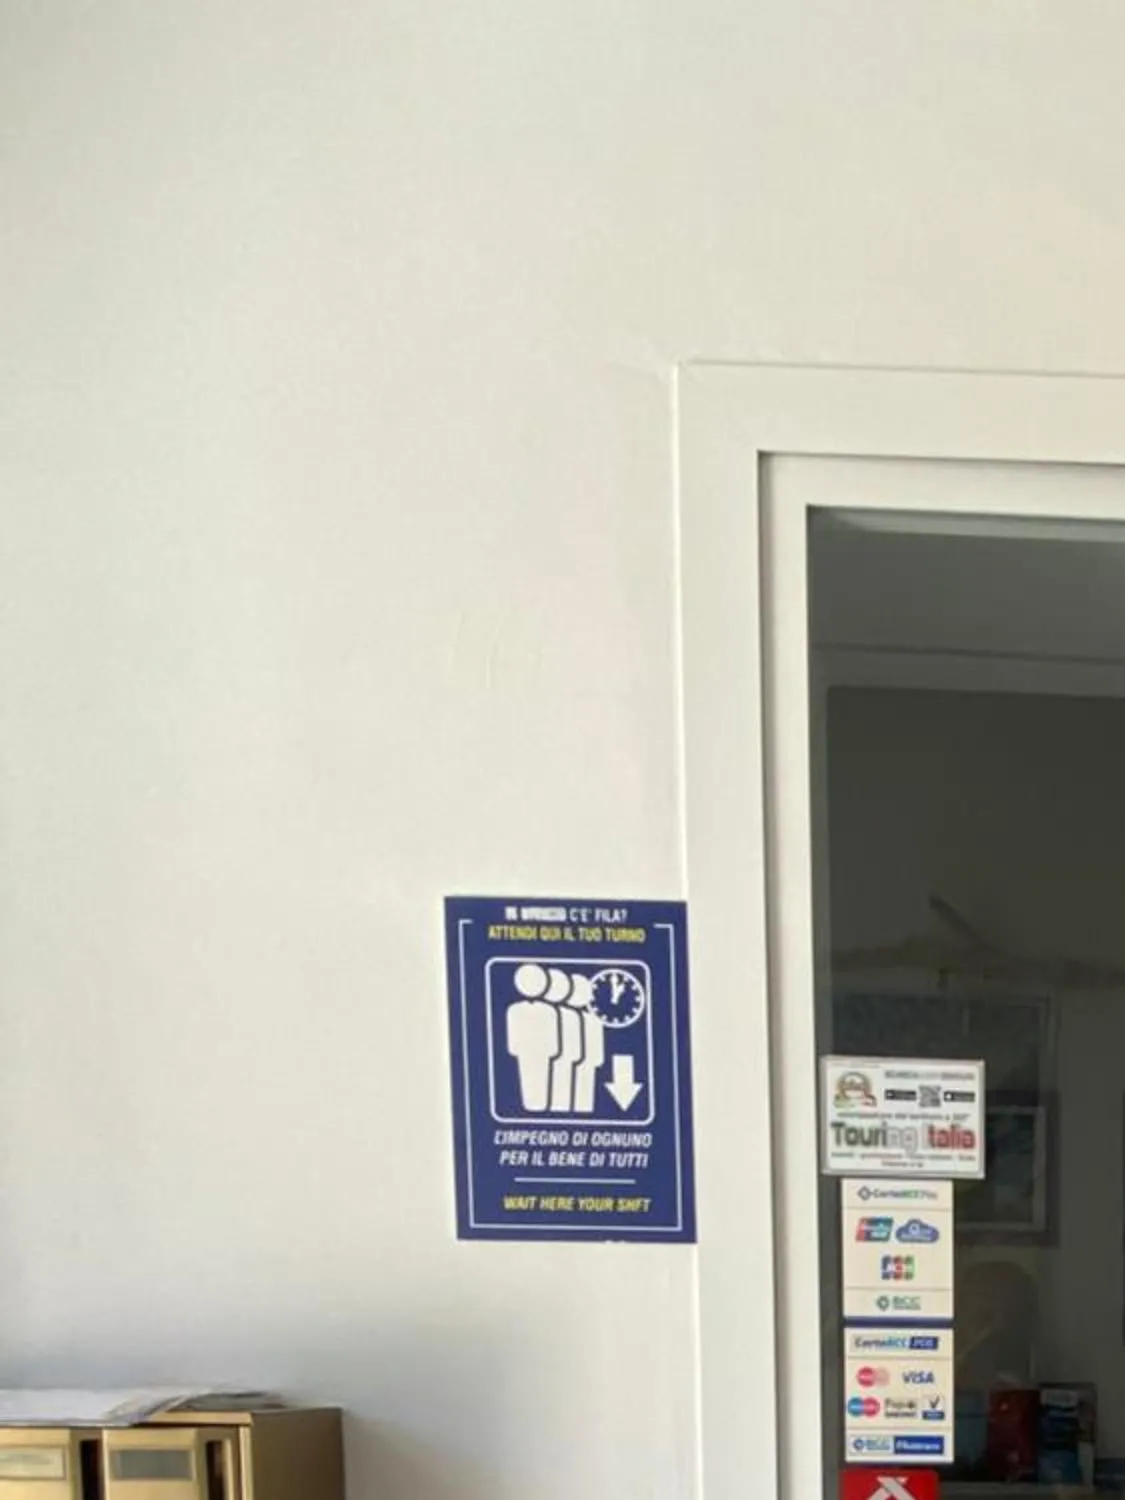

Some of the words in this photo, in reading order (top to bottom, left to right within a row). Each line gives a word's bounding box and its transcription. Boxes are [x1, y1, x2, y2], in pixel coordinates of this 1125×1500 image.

[488, 925, 538, 941] ATTENDI
[572, 1132, 588, 1147] DI
[591, 1132, 653, 1148] OGNUNO
[830, 1121, 918, 1155] Touring
[499, 1150, 529, 1166] PER
[531, 1151, 545, 1167] IL
[548, 1151, 587, 1167] BENE
[589, 1152, 606, 1168] DI
[608, 1153, 649, 1169] TUTTI
[503, 1195, 537, 1210] WAIT
[539, 1196, 575, 1211] HERE
[578, 1196, 614, 1212] YOUR
[902, 1371, 935, 1384] VISA
